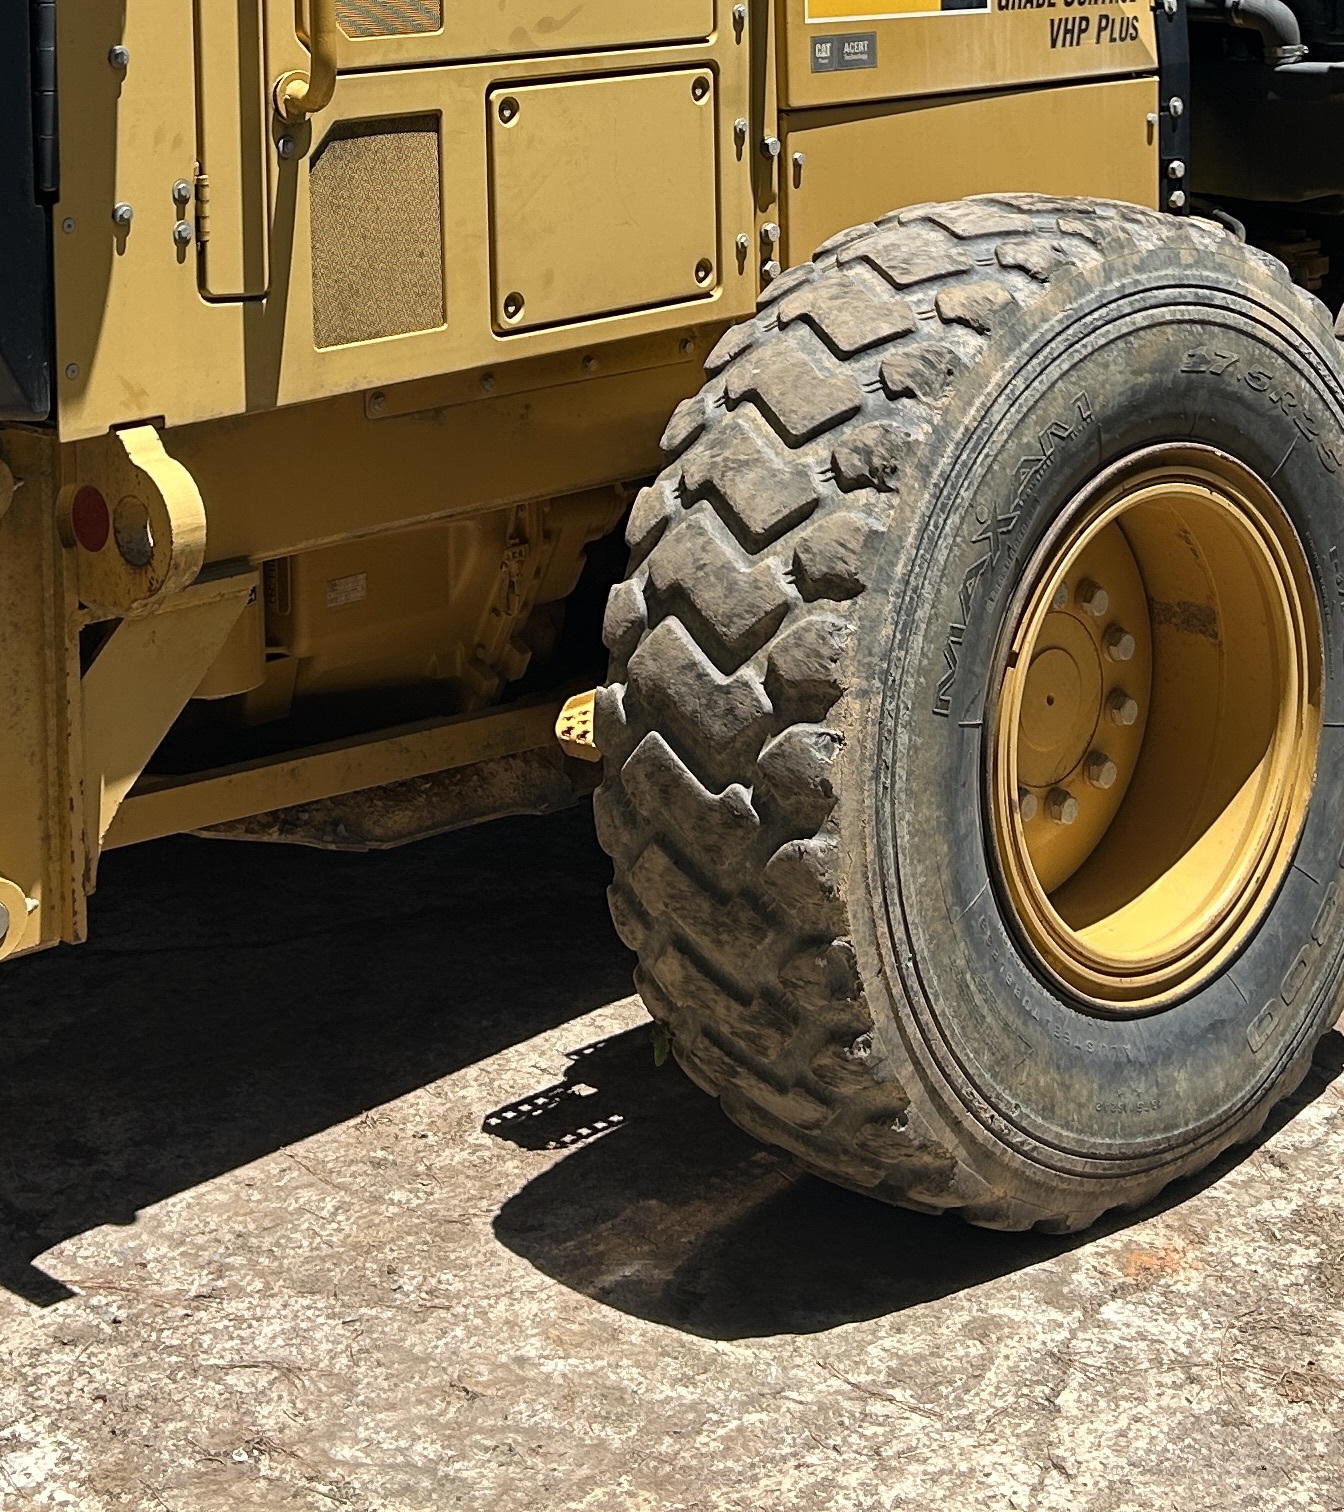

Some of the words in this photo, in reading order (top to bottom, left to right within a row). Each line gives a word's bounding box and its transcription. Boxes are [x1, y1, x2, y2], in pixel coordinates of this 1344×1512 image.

[1049, 15, 1090, 49] VHP
[1095, 14, 1139, 45] PLUS
[815, 42, 832, 58] CAT
[843, 40, 869, 54] ACERT
